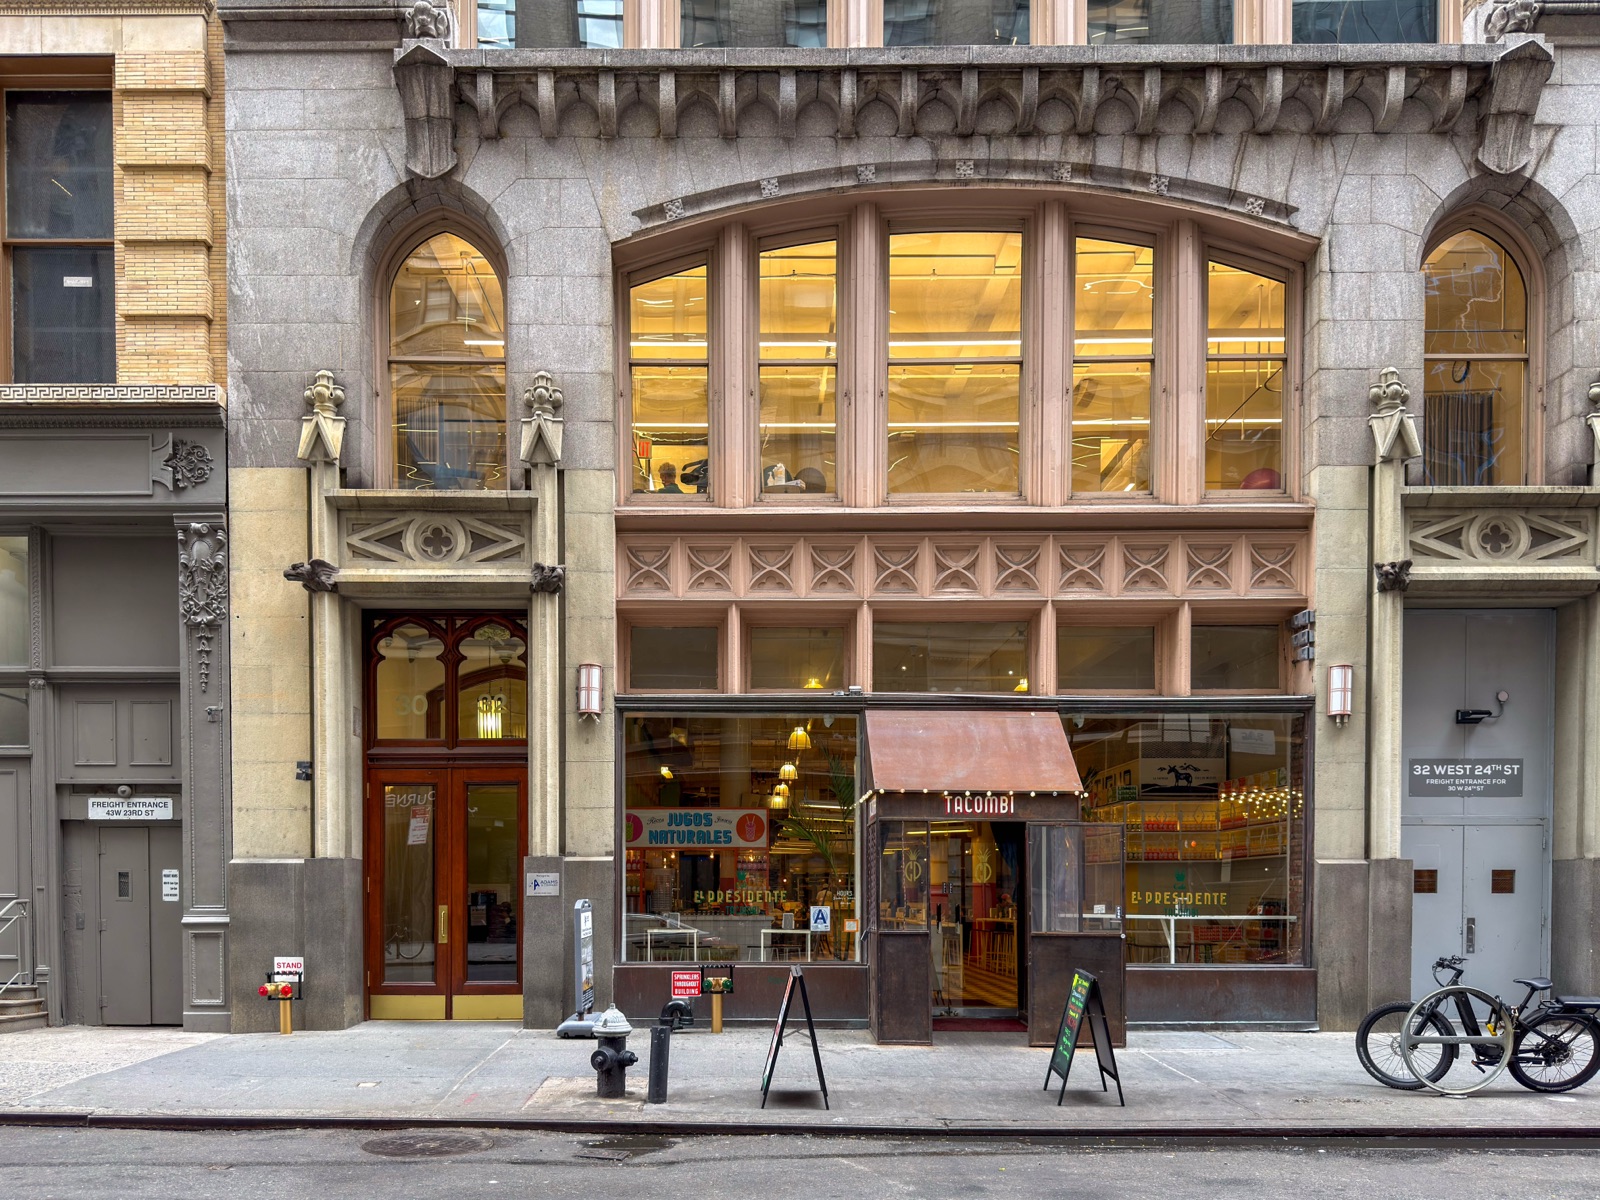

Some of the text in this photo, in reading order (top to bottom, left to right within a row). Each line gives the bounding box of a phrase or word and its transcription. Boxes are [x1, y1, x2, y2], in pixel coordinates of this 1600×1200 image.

[395, 695, 428, 716] 30
[478, 693, 507, 714] 32
[1413, 764, 1520, 775] 32 WEST 24TH ST
[944, 796, 1014, 815] TACOMBI
[667, 812, 713, 827] JUGOS
[648, 830, 732, 844] NATURALES
[707, 890, 788, 903] PRESIDENTE
[1131, 892, 1227, 905] EL PRESIDENTE
[814, 909, 827, 924] A
